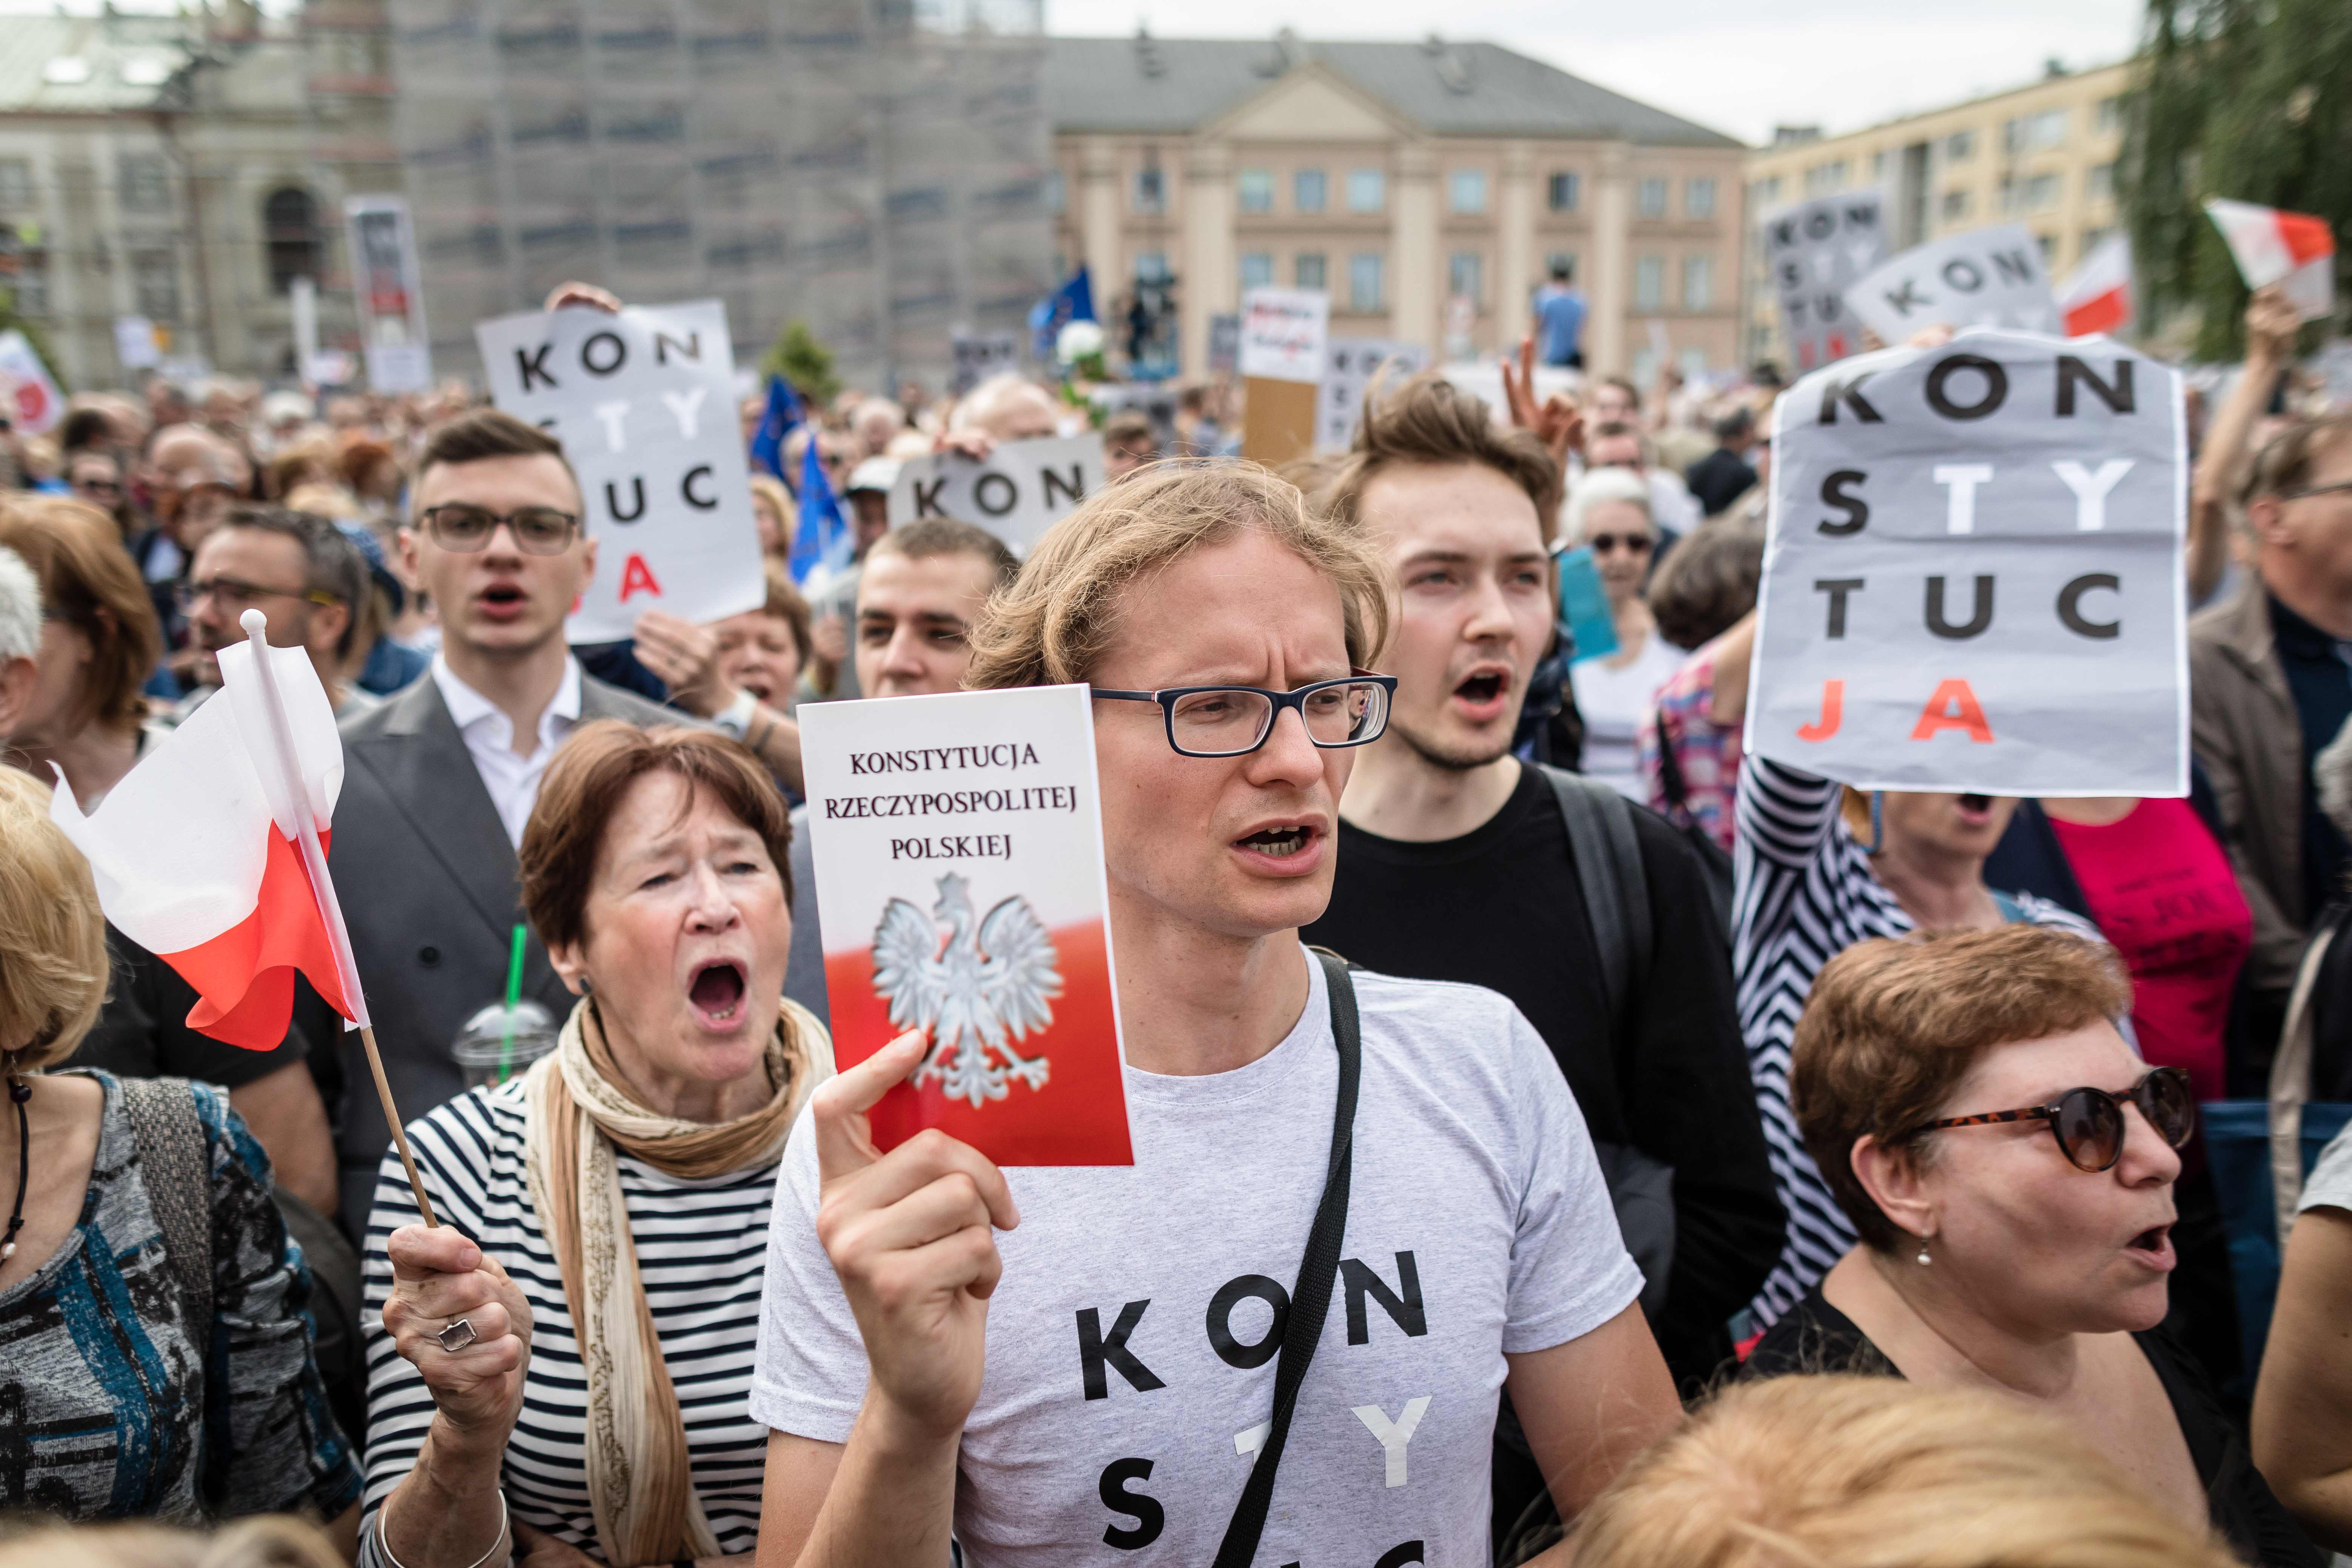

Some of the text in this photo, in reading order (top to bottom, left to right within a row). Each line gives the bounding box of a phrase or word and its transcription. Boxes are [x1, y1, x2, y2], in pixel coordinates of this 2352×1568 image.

[1884, 247, 2035, 316] KON
[514, 331, 701, 392] KON
[1818, 353, 2136, 426] KON
[539, 386, 707, 451] TY
[913, 463, 1085, 518] KON
[1816, 459, 2135, 539] STY
[568, 551, 662, 615] A
[1814, 572, 2122, 641] TUC
[1795, 678, 1996, 744] JA
[850, 742, 1040, 775] KONSTYTUCJA
[824, 786, 1077, 819] RZECZYPOSPOLITEJ
[891, 834, 1012, 861] POLSKIEJ
[1075, 1250, 1428, 1401] KON
